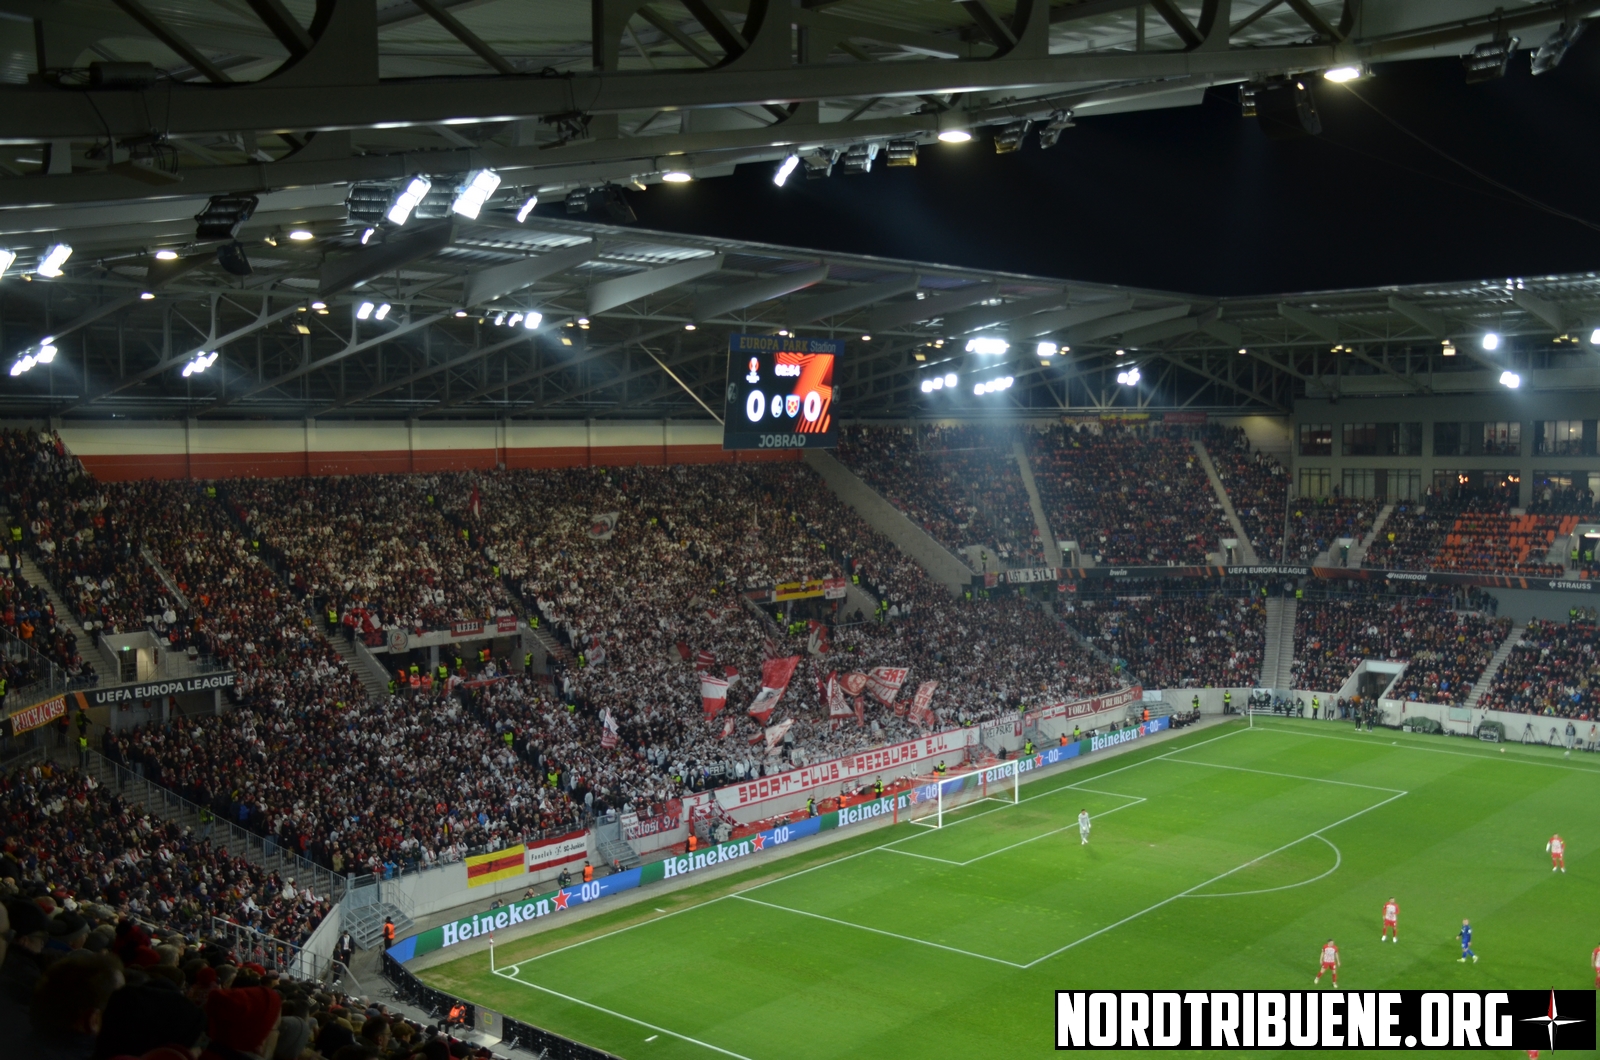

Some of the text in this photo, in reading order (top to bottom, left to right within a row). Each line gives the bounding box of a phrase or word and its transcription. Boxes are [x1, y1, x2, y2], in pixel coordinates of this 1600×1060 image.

[739, 336, 836, 353] EUROPA PARK Stadion
[746, 390, 821, 422] 0 0
[758, 434, 806, 448] JOBRAD
[1033, 568, 1055, 580] SYLT
[1279, 567, 1307, 575] LEAGUE
[1557, 581, 1591, 590] STRAUSS
[96, 674, 235, 704] UEFA EUROPA LEAGUE
[11, 697, 65, 732] MUCHACHOS
[1068, 703, 1090, 716] FORZA
[1091, 727, 1138, 752] Heineken
[738, 763, 840, 804] SPORT-CLUB
[838, 796, 906, 827] Heineken
[531, 850, 552, 860] Fanclub
[663, 841, 750, 880] Heineken
[442, 897, 550, 948] Heineken
